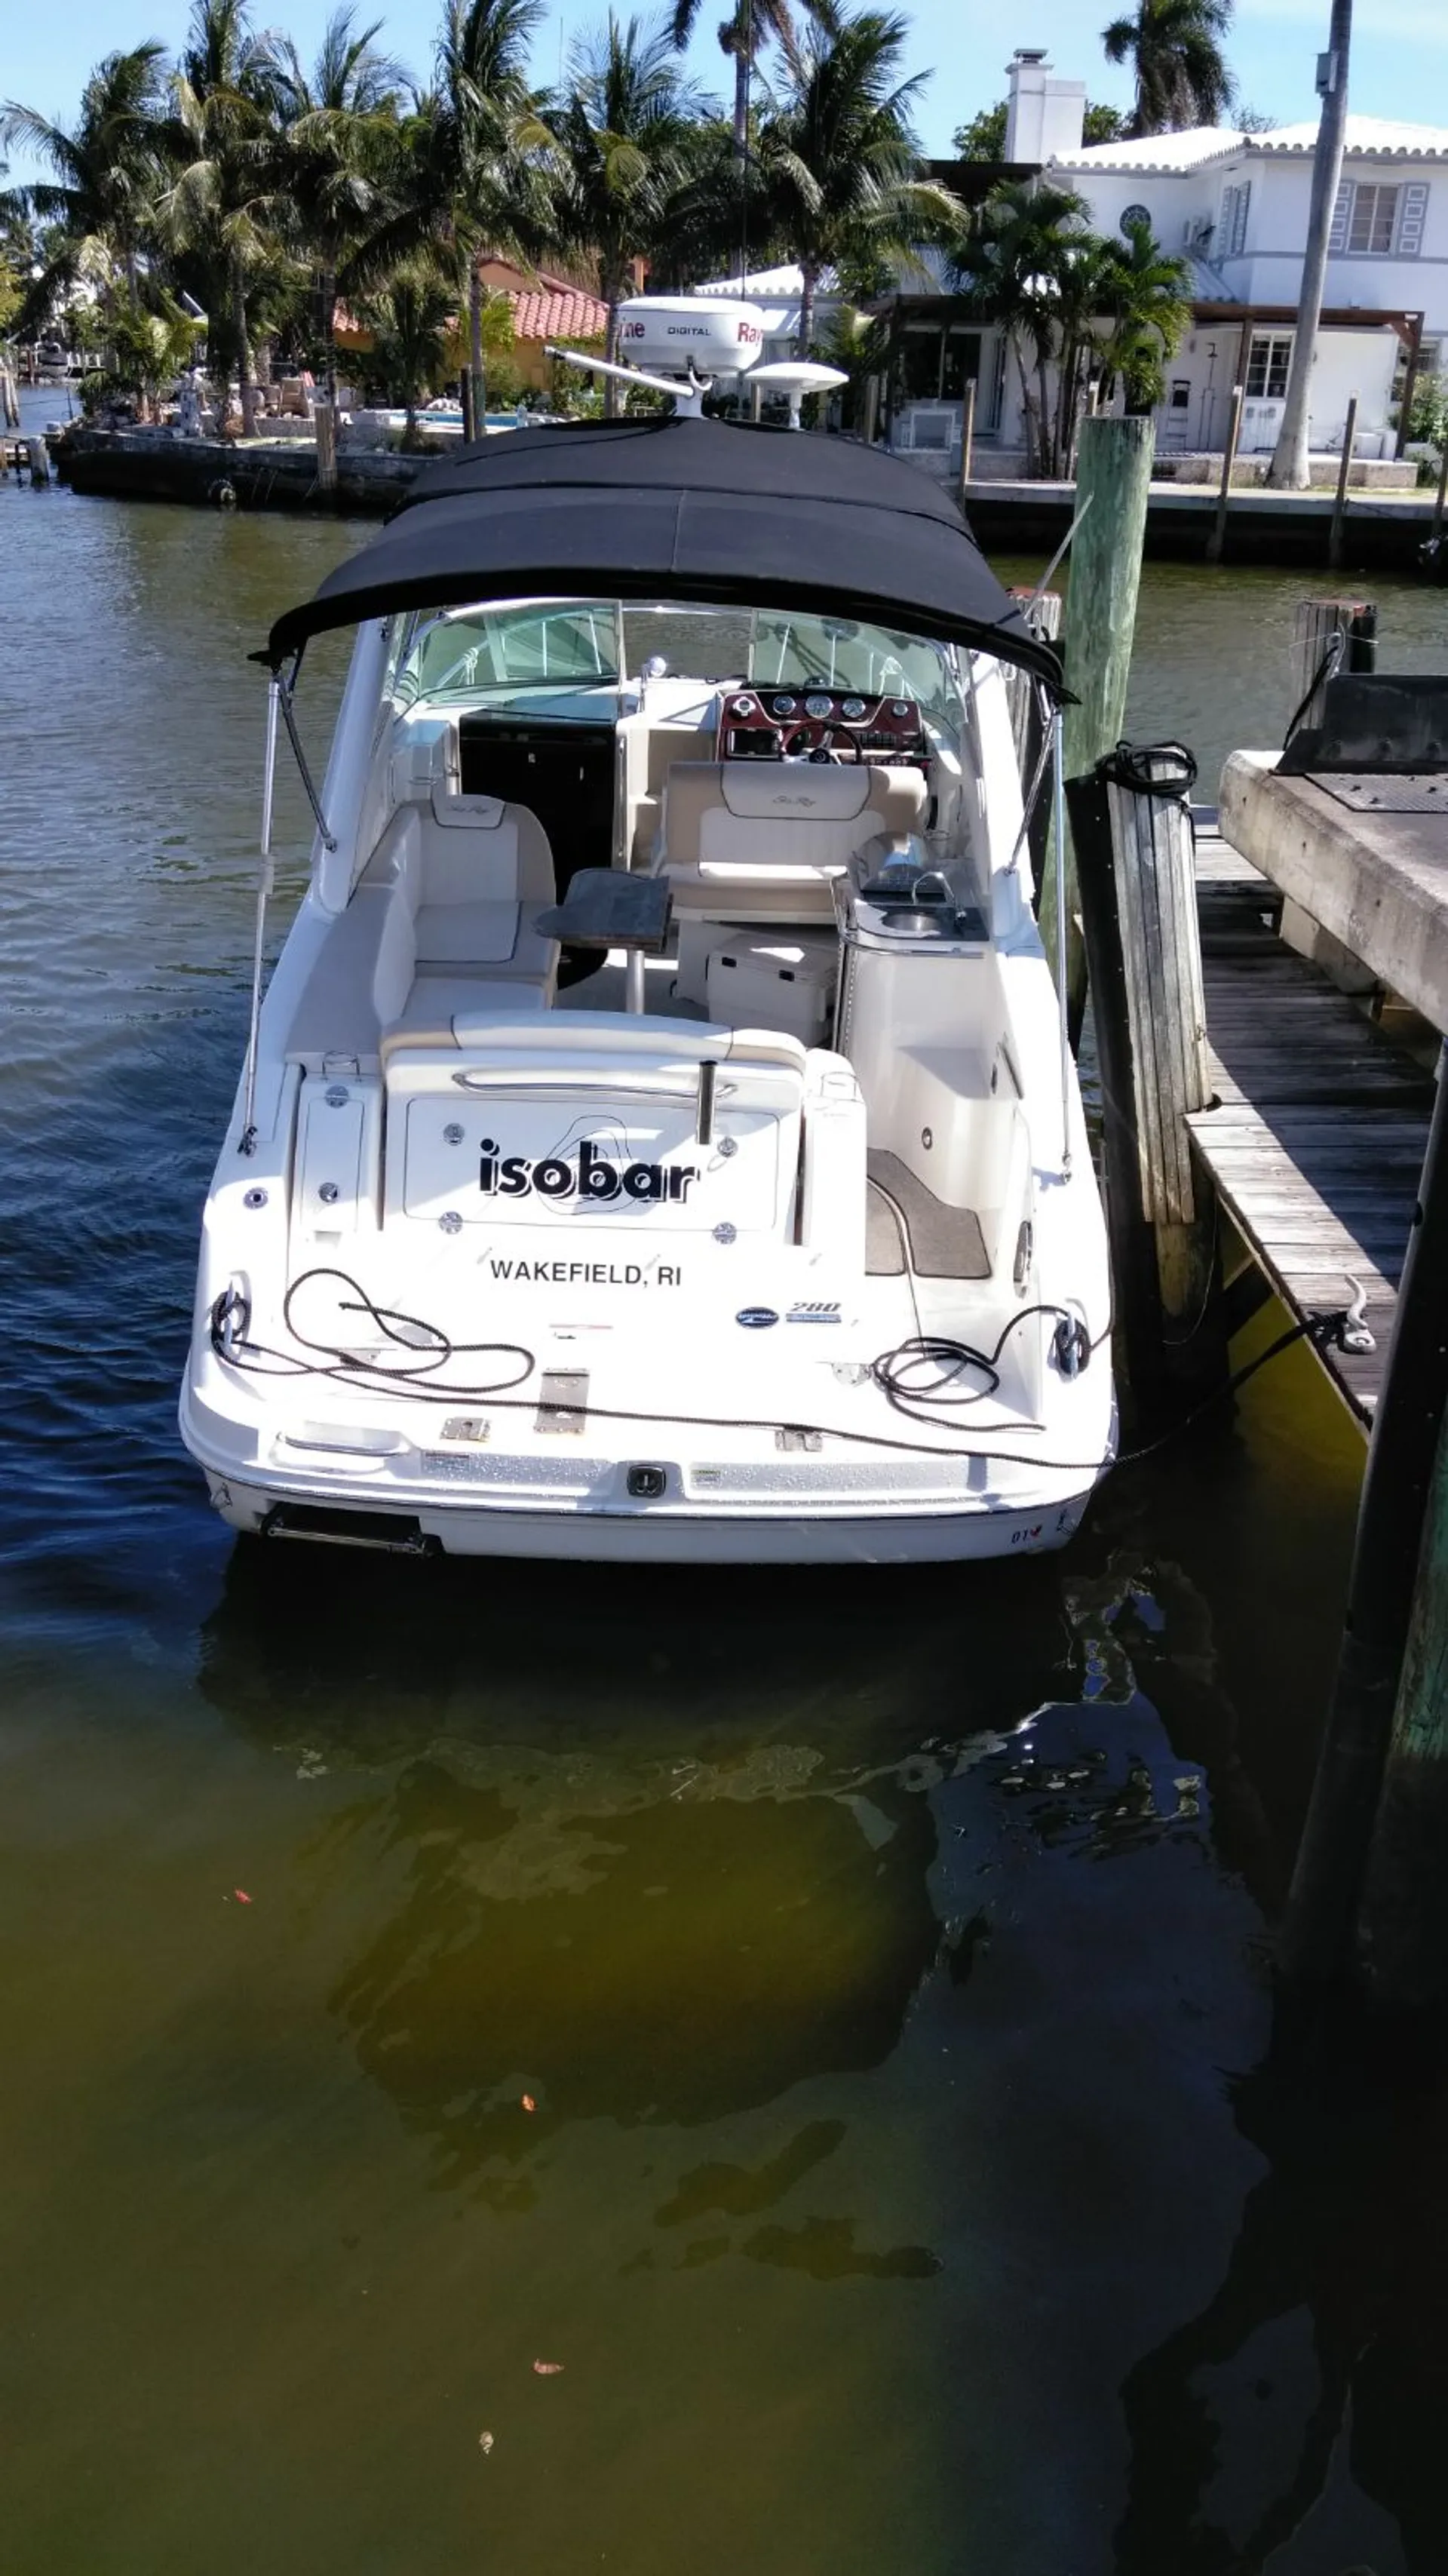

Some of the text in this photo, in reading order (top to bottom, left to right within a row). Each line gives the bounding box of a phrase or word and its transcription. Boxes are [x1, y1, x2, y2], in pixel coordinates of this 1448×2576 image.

[667, 326, 711, 336] DIGITAL
[480, 1138, 700, 1203] isobar
[489, 1259, 681, 1288] WAKEFIELD, RI
